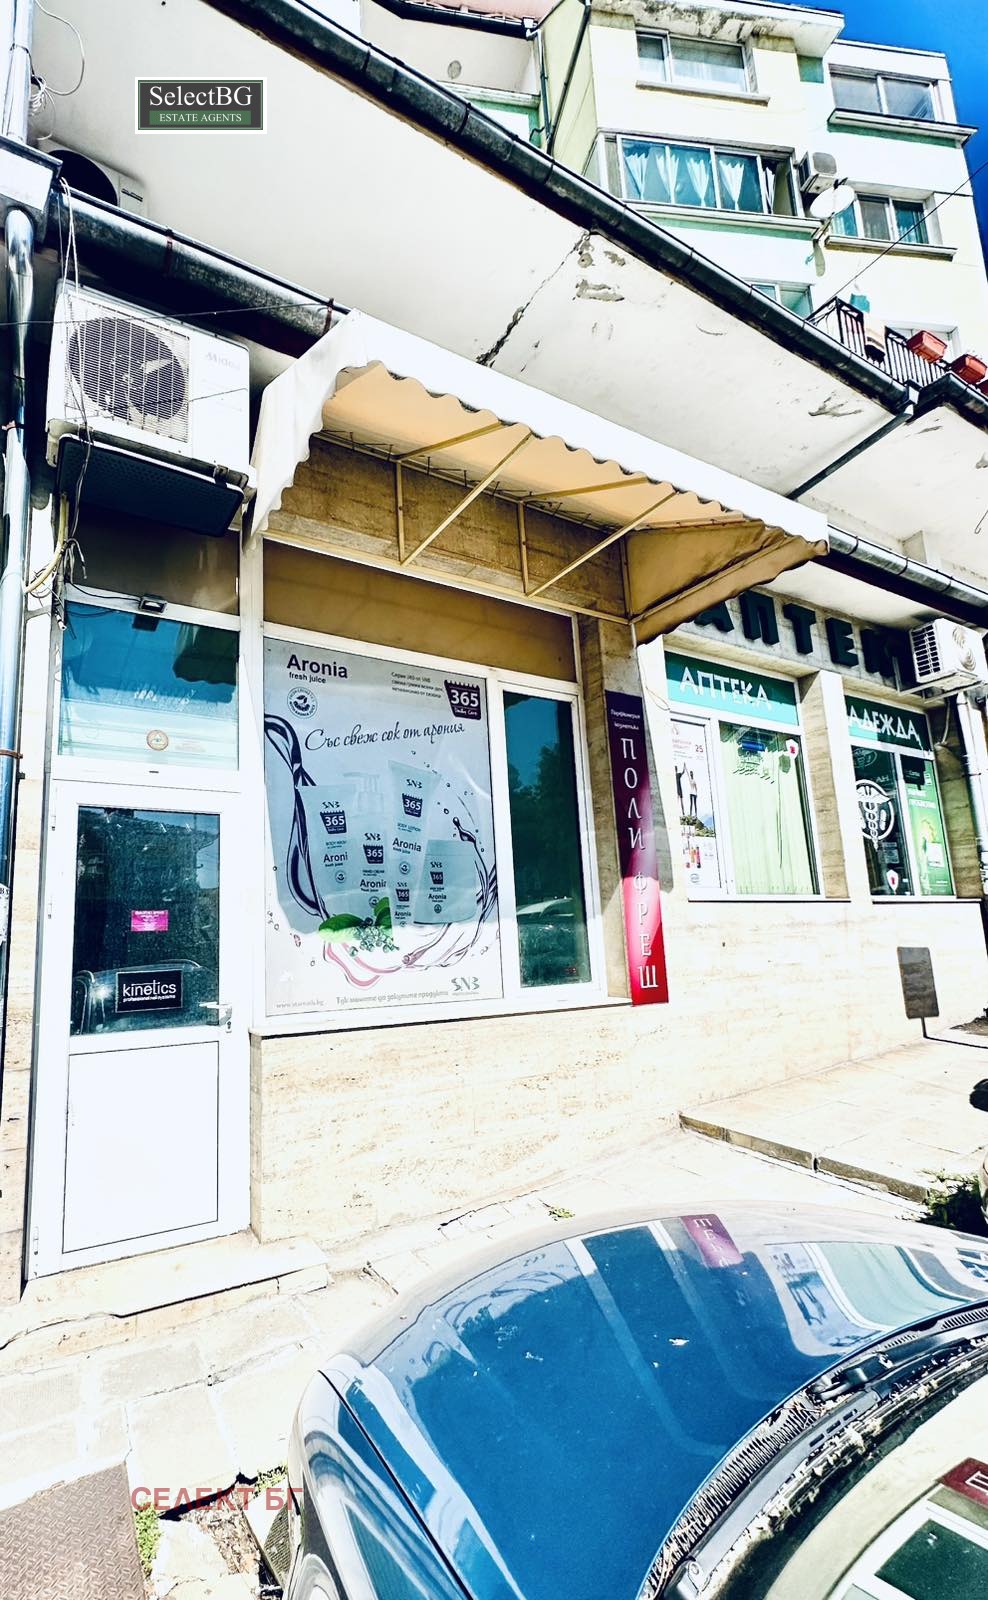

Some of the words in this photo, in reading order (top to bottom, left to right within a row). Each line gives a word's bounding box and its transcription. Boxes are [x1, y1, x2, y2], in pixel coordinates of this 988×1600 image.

[286, 654, 348, 679] Aronia
[289, 671, 308, 681] fresh
[309, 674, 327, 684] juice
[680, 666, 773, 712] АПТЕКА
[450, 689, 479, 707] 365
[848, 705, 921, 742] АДЕЖДА
[304, 728, 341, 751] Със
[343, 724, 379, 746] свеж
[381, 721, 402, 742] сок
[402, 729, 421, 739] от
[423, 723, 466, 745] арония
[695, 744, 704, 753] 25
[404, 798, 422, 811] 365
[325, 816, 345, 827] 365
[392, 837, 422, 852] Aronia
[366, 849, 383, 857] 365
[123, 979, 177, 997] kinetics
